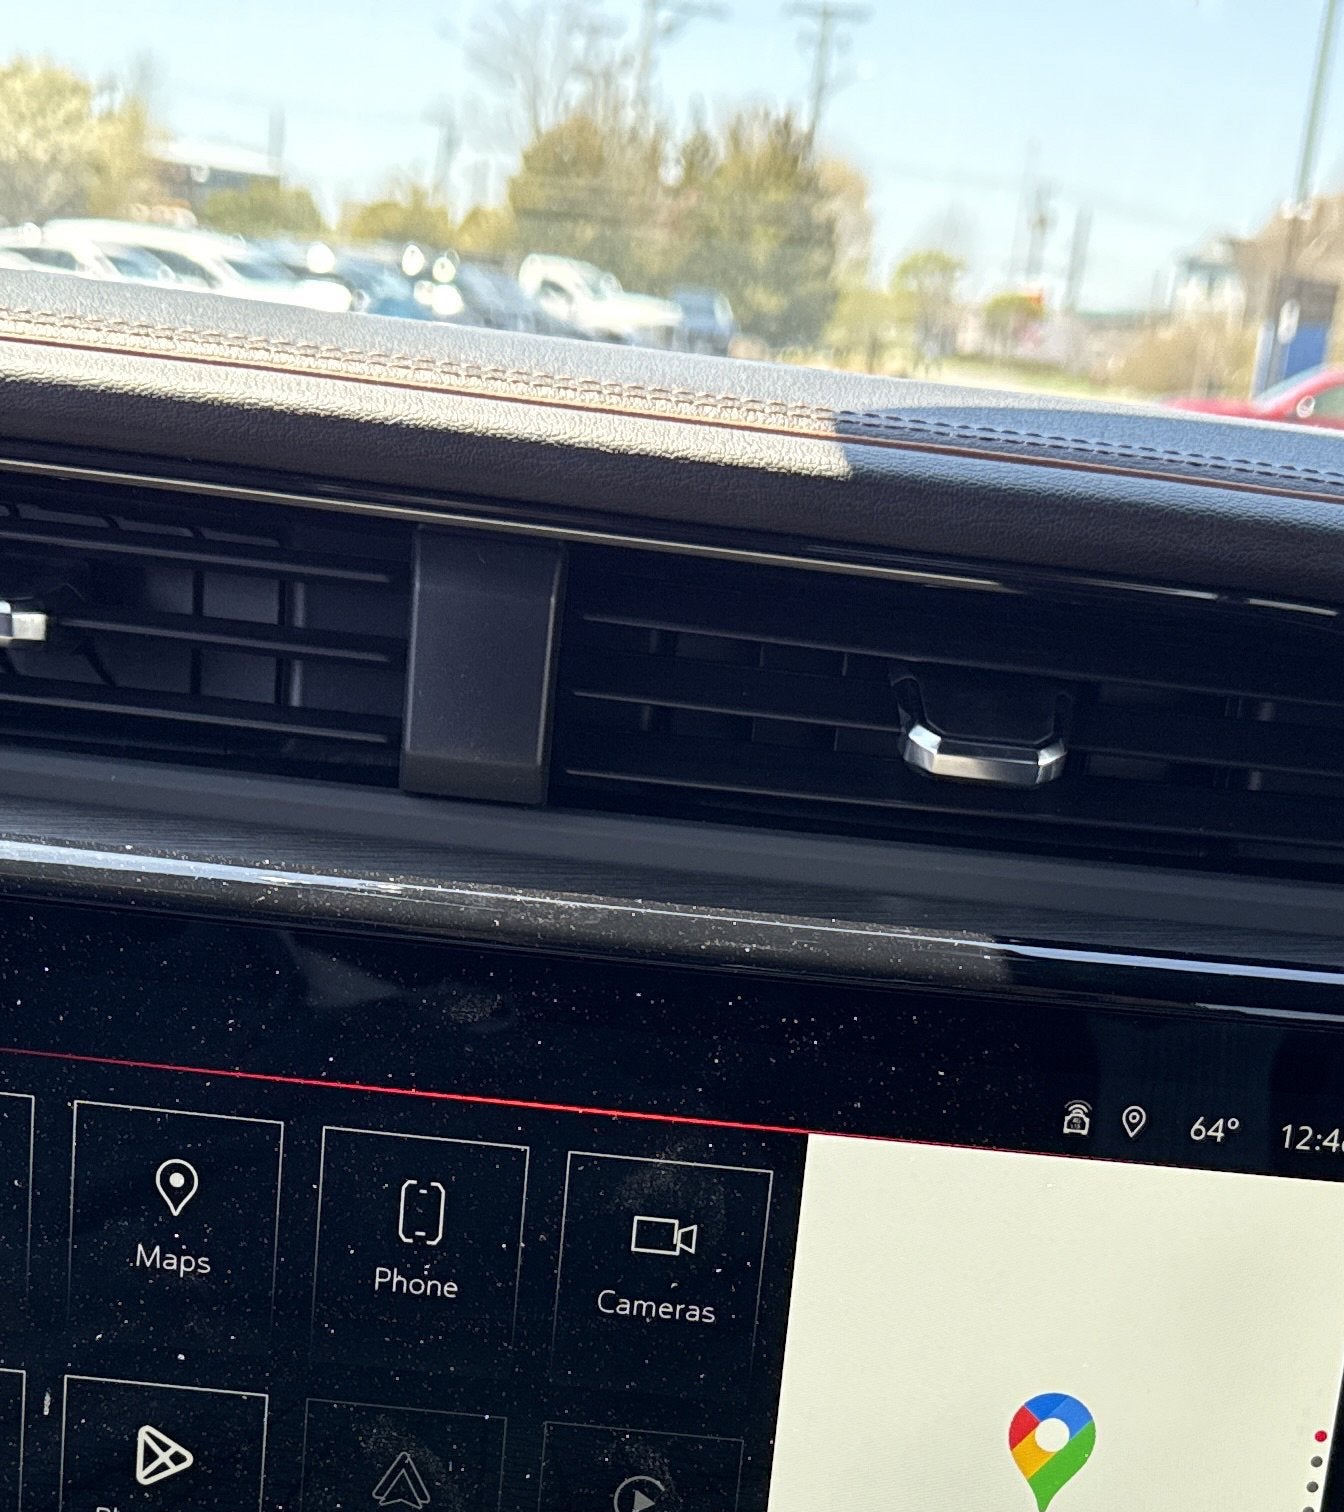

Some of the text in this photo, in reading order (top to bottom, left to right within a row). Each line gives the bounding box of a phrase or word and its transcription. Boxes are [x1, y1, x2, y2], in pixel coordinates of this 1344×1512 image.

[1190, 1116, 1240, 1143] 64°
[135, 1243, 211, 1275] Maps
[374, 1267, 458, 1298] Phone
[597, 1289, 716, 1323] Cameras
